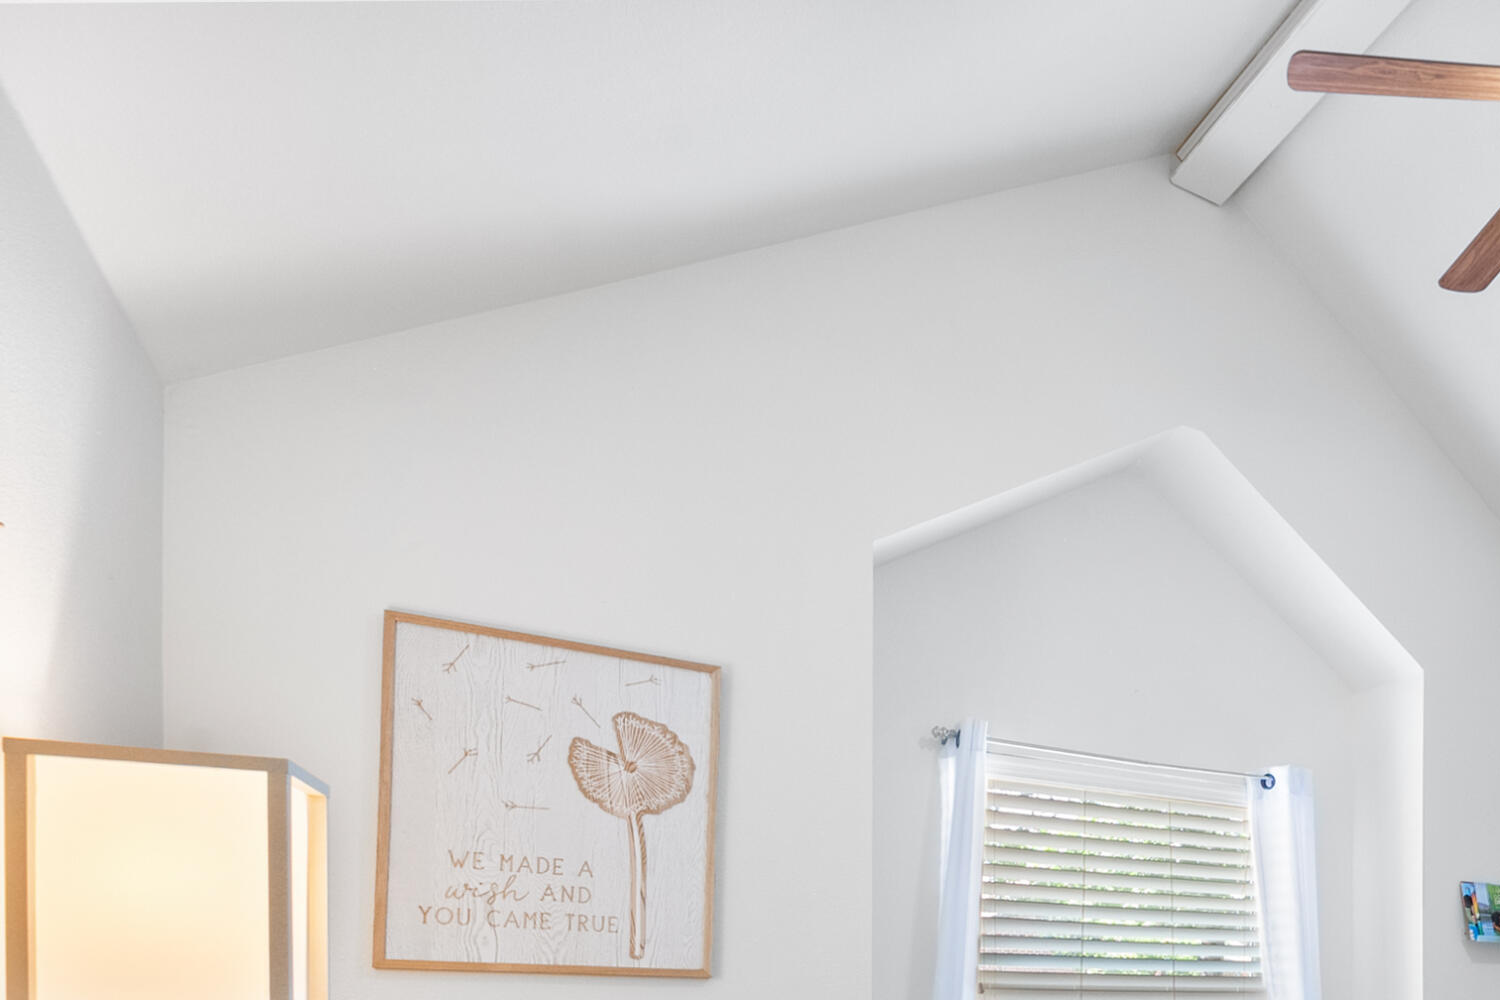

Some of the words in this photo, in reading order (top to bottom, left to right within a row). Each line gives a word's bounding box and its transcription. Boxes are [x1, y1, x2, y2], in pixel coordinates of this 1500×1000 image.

[448, 850, 485, 870] WE
[500, 854, 564, 876] MADE
[577, 861, 594, 878] A
[444, 874, 530, 905] wish
[540, 884, 592, 904] AND
[418, 905, 471, 926] YOU
[487, 910, 552, 930] CAME
[565, 913, 619, 933] TRUE
